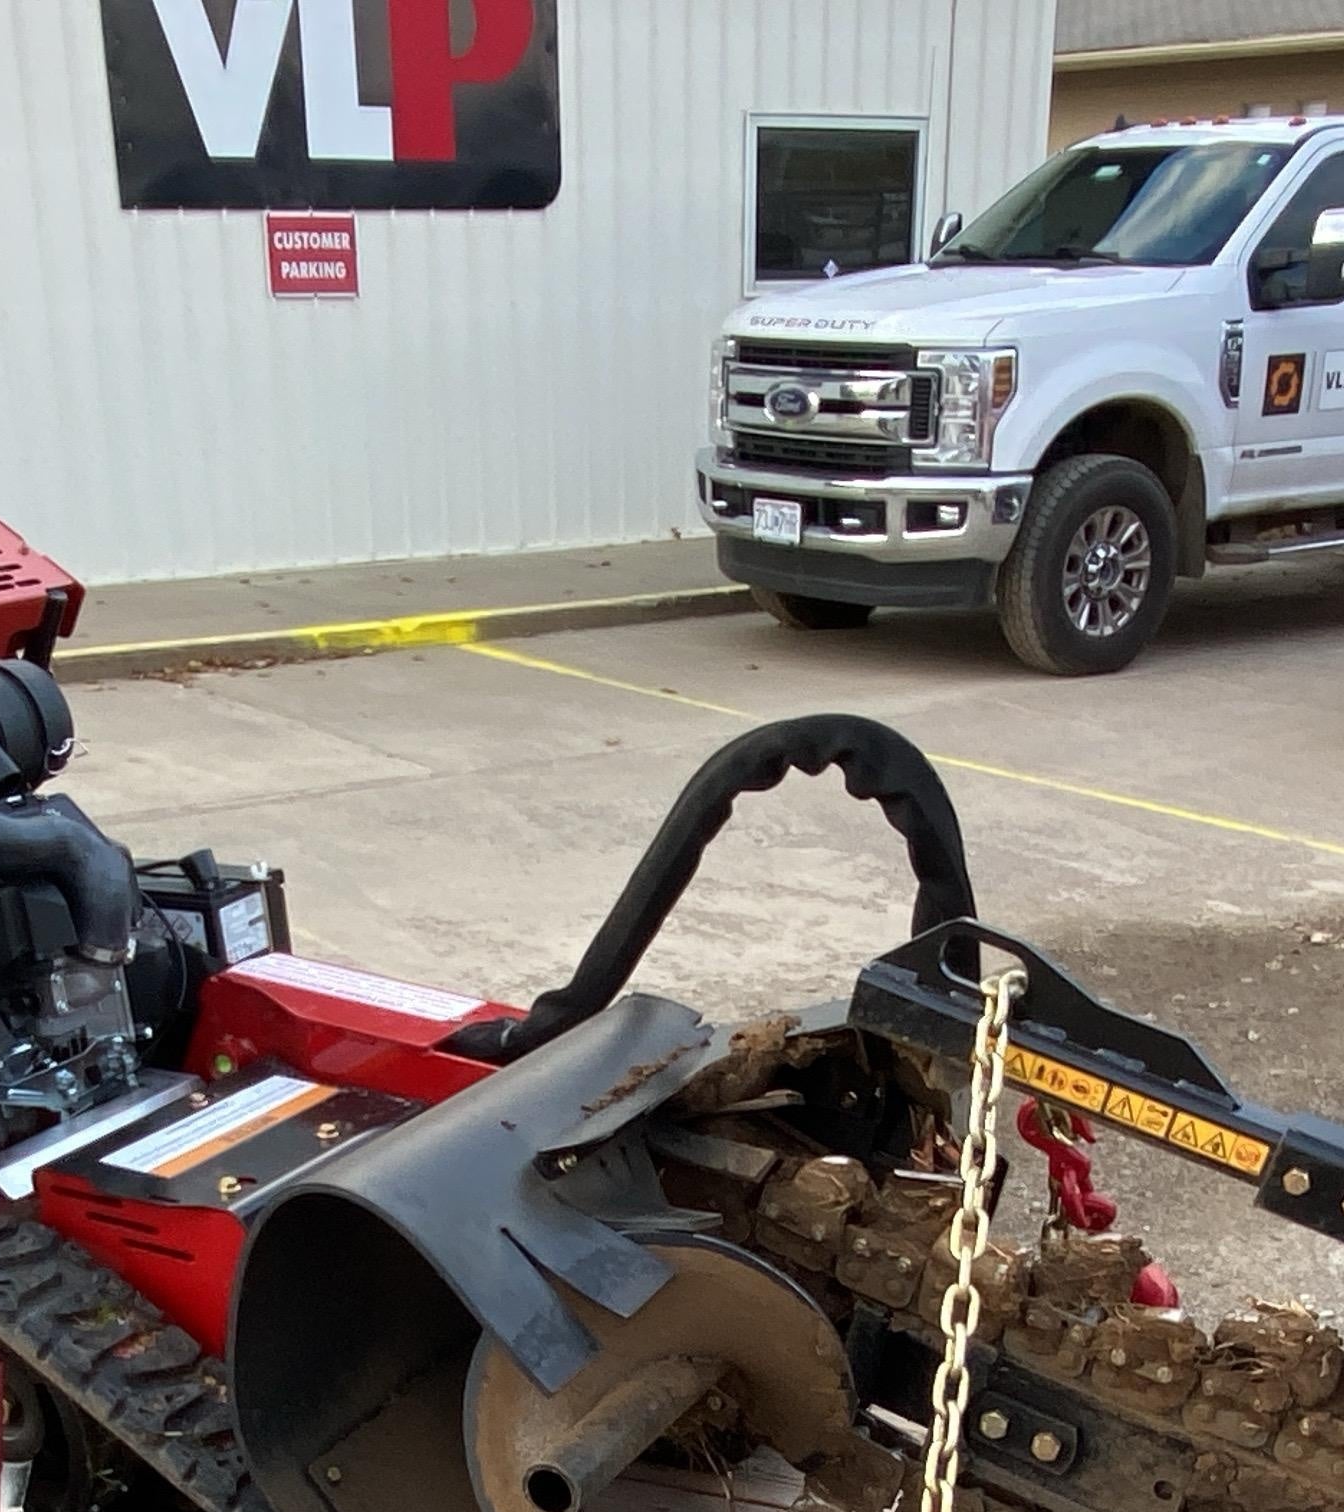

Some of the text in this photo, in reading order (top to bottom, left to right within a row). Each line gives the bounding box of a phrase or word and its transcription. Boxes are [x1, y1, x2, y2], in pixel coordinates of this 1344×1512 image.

[154, 0, 535, 161] VLP
[273, 231, 352, 250] CUSTOMER
[280, 261, 347, 279] PARKING
[749, 315, 876, 330] SUPER DUTY
